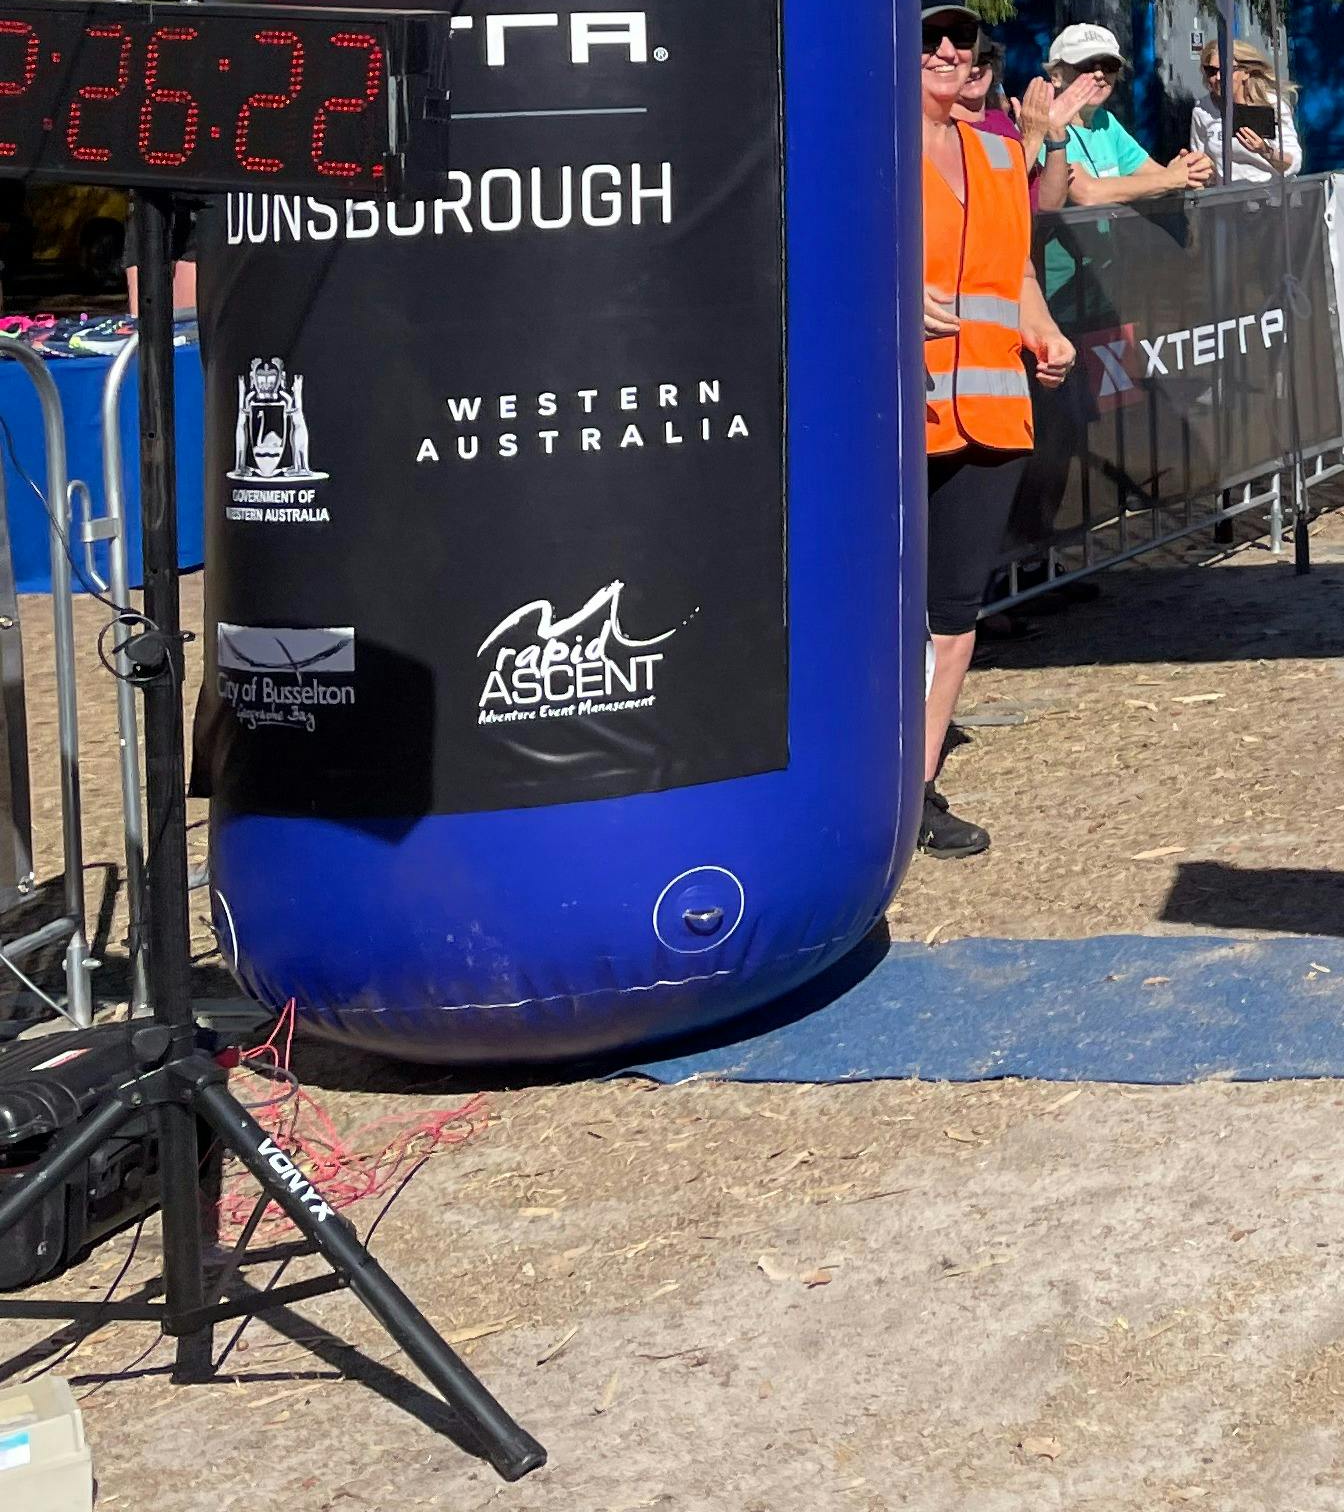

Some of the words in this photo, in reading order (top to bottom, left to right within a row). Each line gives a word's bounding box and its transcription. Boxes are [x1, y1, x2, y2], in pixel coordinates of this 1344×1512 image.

[447, 379, 721, 422] WESTERN
[415, 414, 750, 463] AUSTRALIA
[264, 507, 331, 522] AUSTRALIA
[297, 489, 316, 504] OF
[495, 619, 612, 679] rapid
[241, 675, 258, 702] of
[262, 676, 356, 705] Busselton
[478, 653, 664, 708] ASCENT
[478, 709, 537, 726] Adventure
[538, 704, 577, 718] Event
[577, 694, 657, 716] Management
[257, 1137, 336, 1223] VONYX
